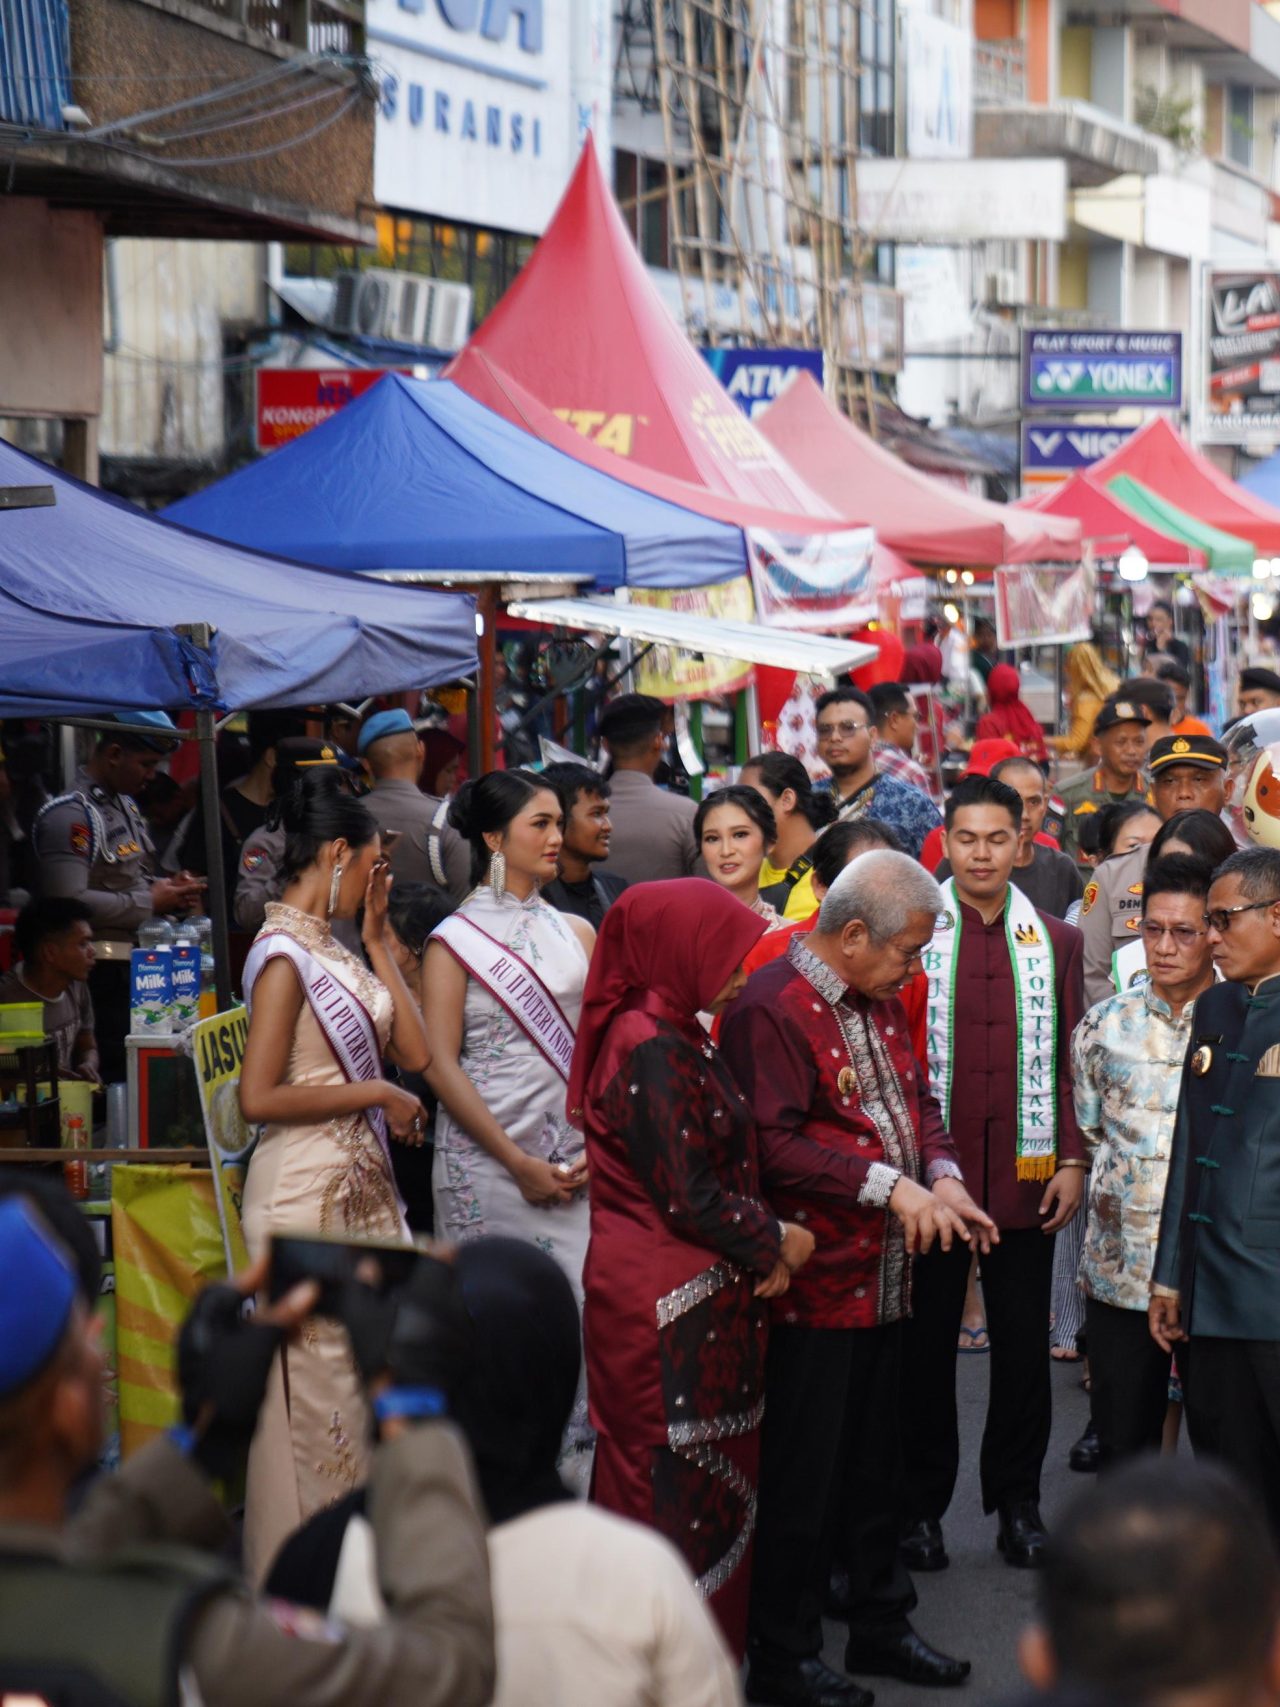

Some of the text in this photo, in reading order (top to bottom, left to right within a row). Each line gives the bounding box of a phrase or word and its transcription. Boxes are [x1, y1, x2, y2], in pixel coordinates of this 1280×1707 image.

[727, 364, 800, 397] ATM
[1088, 361, 1168, 392] YONEX
[135, 973, 166, 991] Milk
[138, 962, 165, 973] Diamond
[171, 968, 196, 986] Milk
[489, 956, 516, 983] RU
[516, 985, 555, 1035] PUTERI
[311, 975, 336, 1001] RU
[330, 1005, 369, 1063] PUTERI
[926, 951, 942, 1094] BUJAN
[1026, 956, 1045, 1128] PONTIANAK
[1021, 1138, 1051, 1151] 2024
